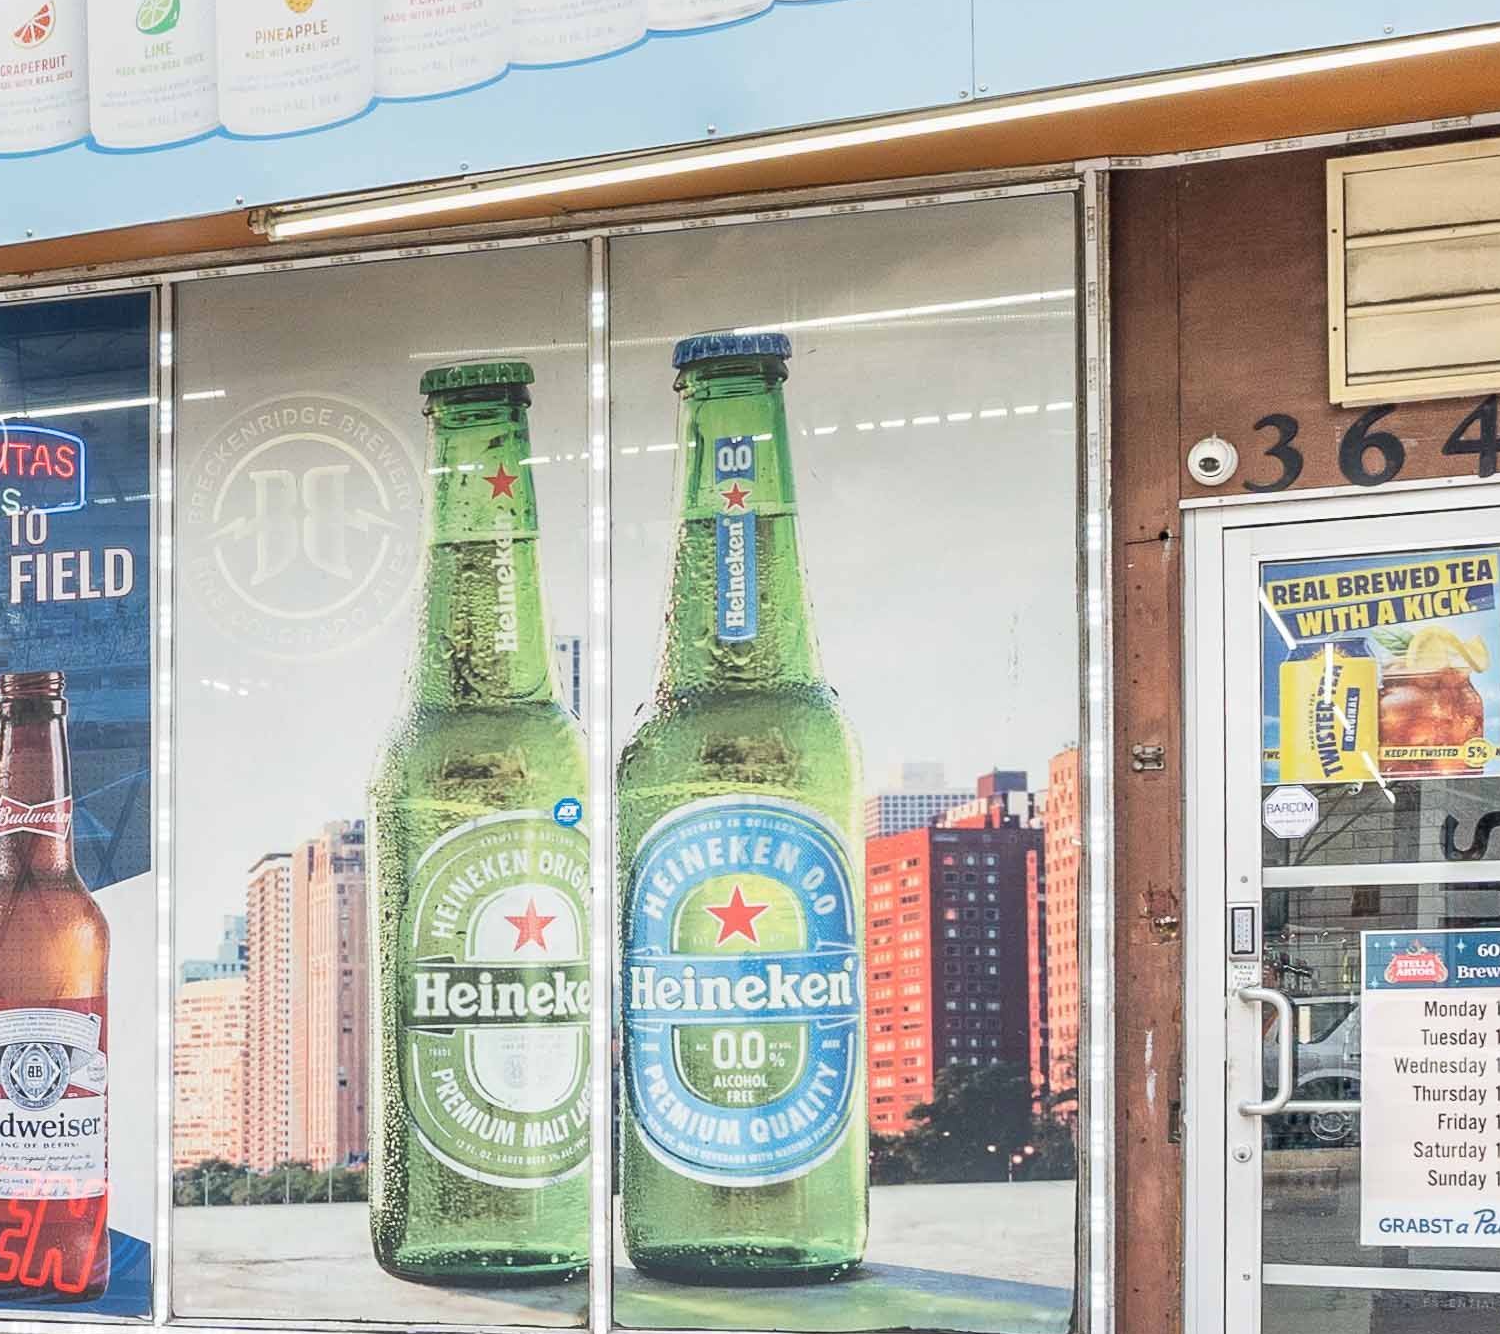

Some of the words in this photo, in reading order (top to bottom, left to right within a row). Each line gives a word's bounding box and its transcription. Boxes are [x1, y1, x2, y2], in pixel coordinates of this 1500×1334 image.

[254, 19, 328, 44] PINEAPPLE
[144, 41, 173, 60] LIME
[0, 55, 67, 77] GRAPEFRUIT
[11, 510, 47, 546] TO
[10, 547, 134, 605] FIELD
[493, 514, 518, 652] Heineken
[723, 519, 745, 628] Heineken
[1272, 581, 1330, 606] REAL
[1337, 565, 1440, 597] BREWED
[1447, 559, 1493, 583] TEA
[1296, 605, 1370, 636] WITH
[1378, 602, 1397, 625] A
[1404, 588, 1478, 620] KICK.
[1316, 699, 1343, 777] TWISTED
[1384, 749, 1410, 758] KEEP
[1411, 749, 1419, 757] IT
[1420, 748, 1458, 757] TWISTED
[1467, 746, 1488, 759] 5%
[557, 808, 578, 816] ADT
[1266, 802, 1314, 814] BARCOM
[643, 836, 800, 920] HEINEKEN
[802, 865, 837, 915] 0.0
[430, 849, 530, 939] HEINEKEN
[1396, 960, 1435, 968] STELLA
[1396, 968, 1437, 977] ARTOIS
[630, 964, 853, 1011] Heineken
[1425, 1001, 1487, 1020] Monday
[1421, 1028, 1487, 1048] Tuesday
[712, 1029, 766, 1069] 0.0
[769, 1052, 785, 1068] %
[1394, 1057, 1487, 1077] Wednesday
[713, 1075, 768, 1088] ALCOHOL
[643, 1063, 740, 1145] PREMIUM
[750, 1062, 838, 1143] QUALITY
[727, 1090, 755, 1103] FREE
[1413, 1085, 1487, 1105] Thursday
[432, 1068, 516, 1146] PREMIUM
[524, 1115, 569, 1147] MALT
[1438, 1114, 1487, 1133] Friday
[1414, 1142, 1487, 1161] Saturday
[1428, 1170, 1487, 1190] Sunday
[1379, 1218, 1453, 1234] GRABST
[1456, 1222, 1468, 1234] a
